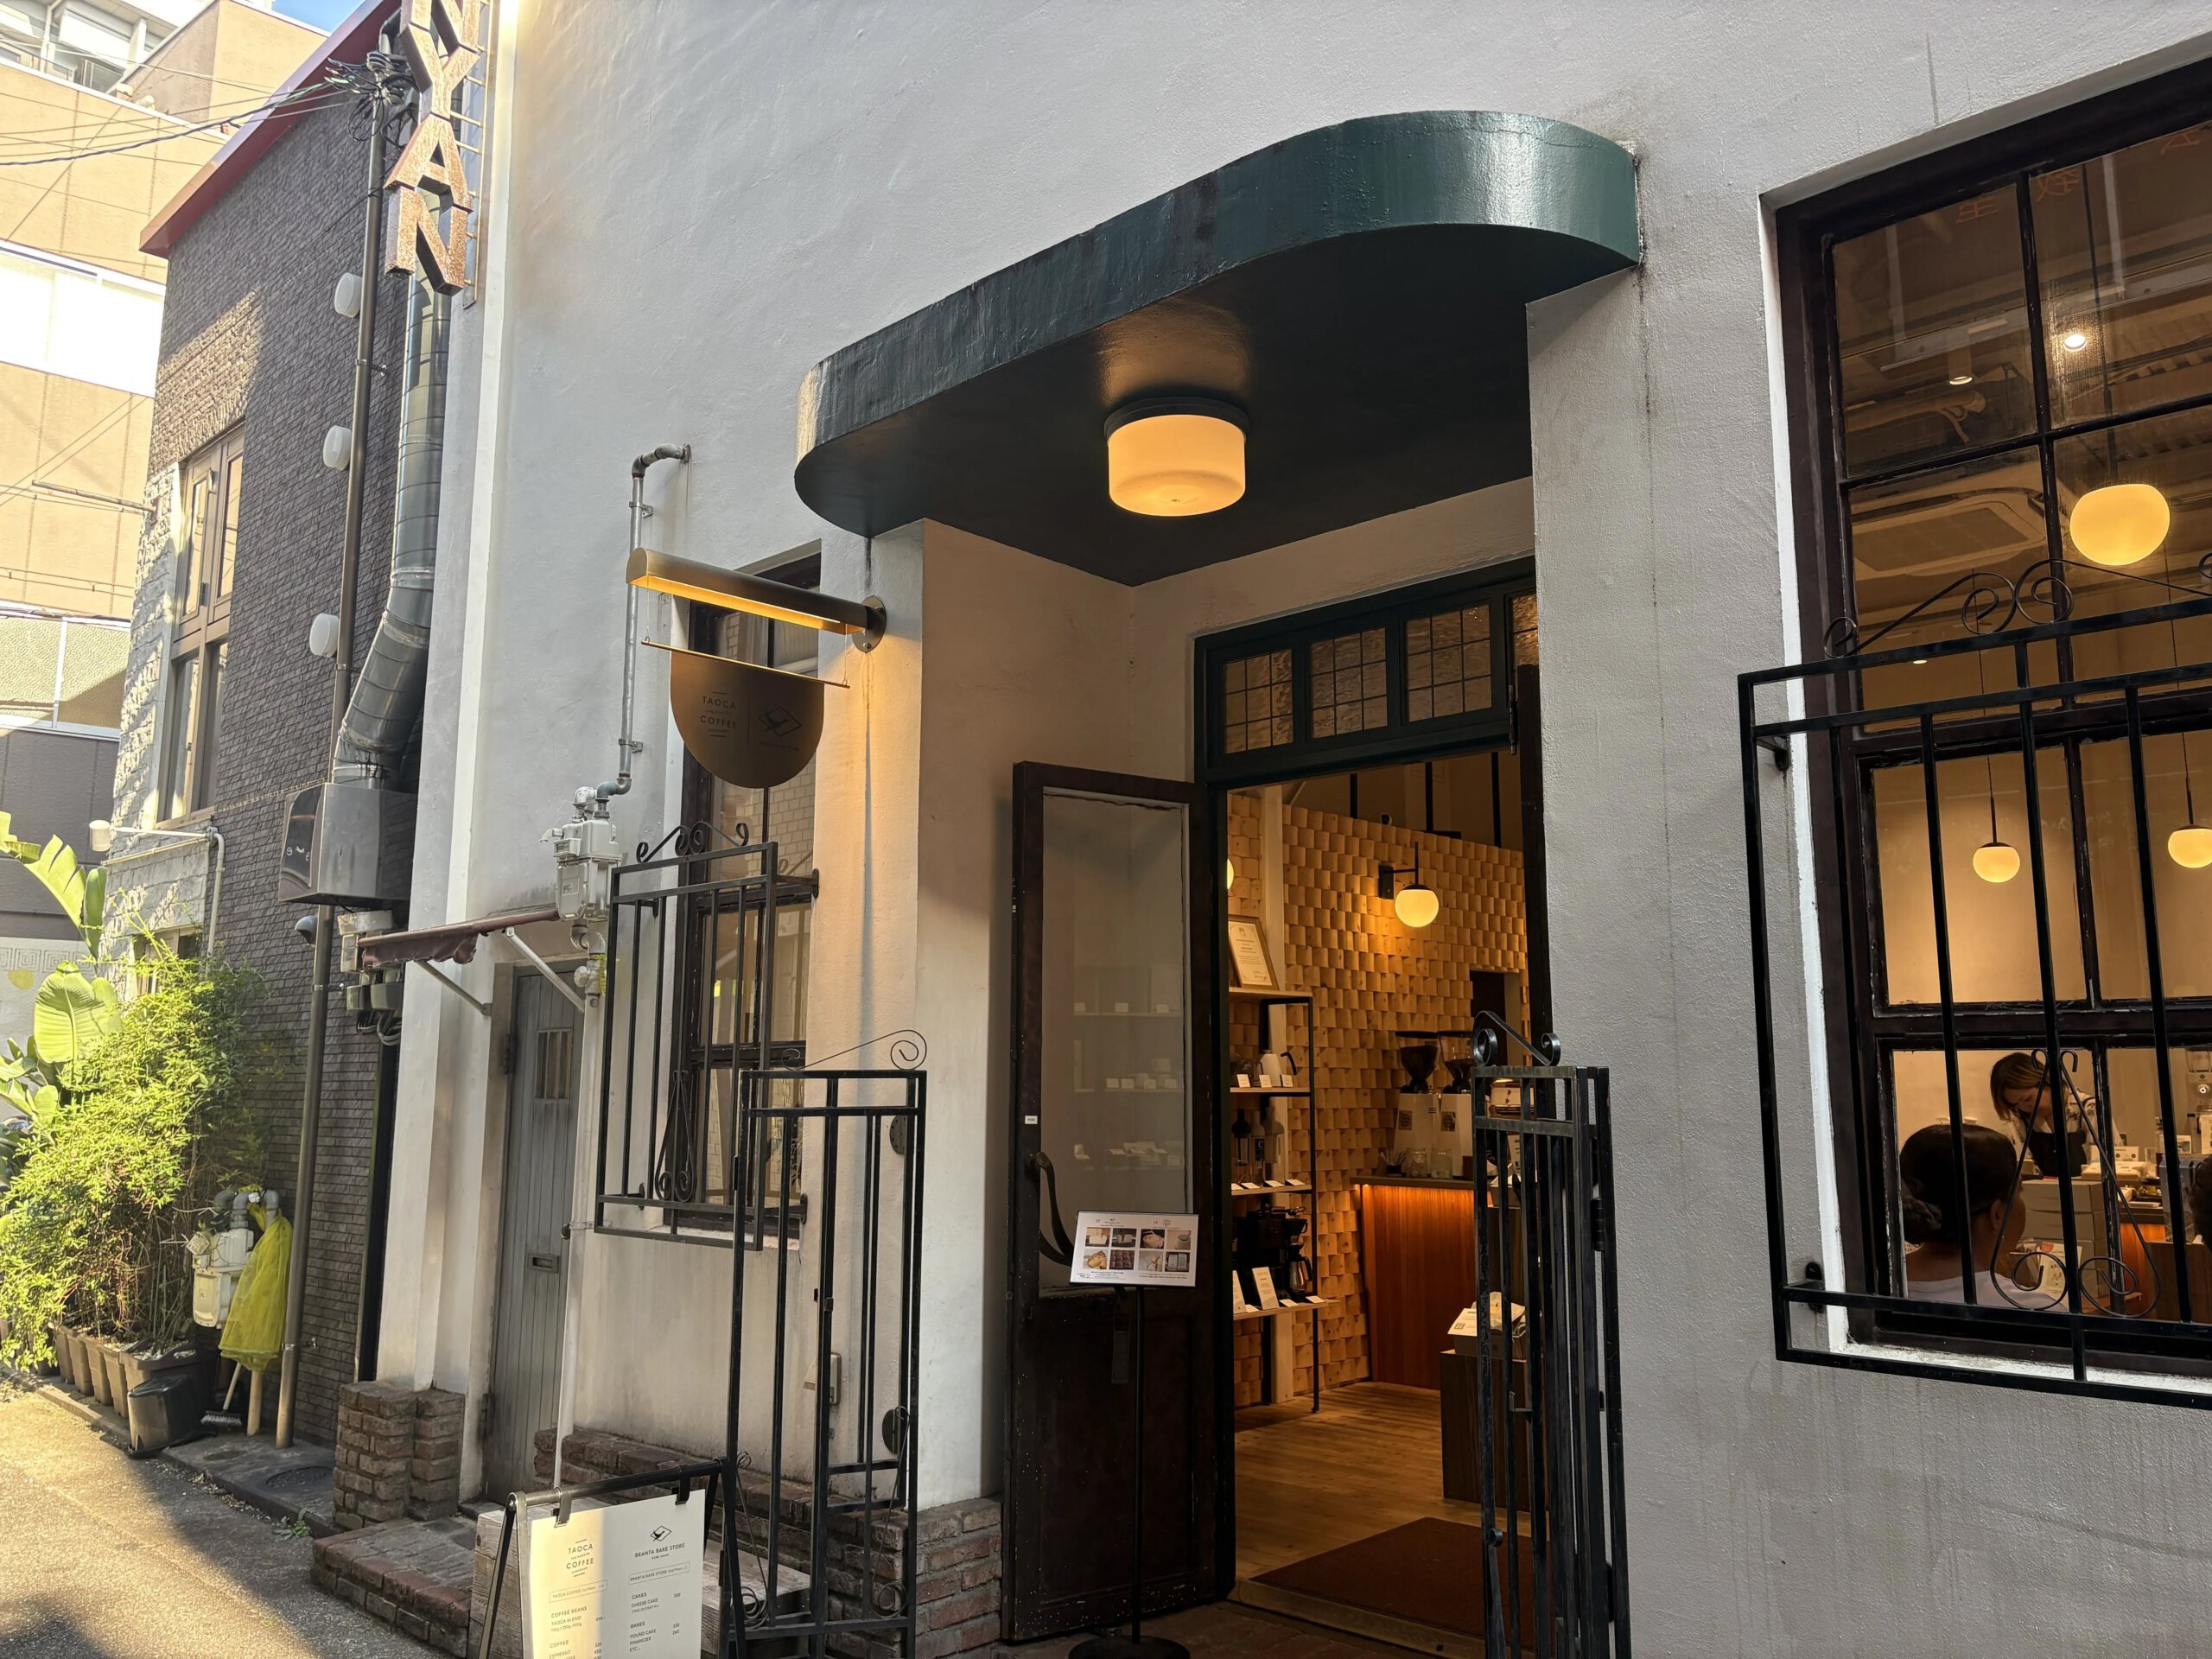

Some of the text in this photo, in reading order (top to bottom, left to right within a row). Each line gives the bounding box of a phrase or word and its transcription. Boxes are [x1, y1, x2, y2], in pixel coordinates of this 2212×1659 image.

[702, 696, 736, 709] TAOCA
[700, 715, 736, 729] COFFEE
[568, 1543, 594, 1554] TAOCA
[635, 1549, 654, 1558] BRANTA
[670, 1542, 685, 1551] STORE
[566, 1558, 594, 1569] COFFEE
[550, 1605, 588, 1618] COFFEE BEANS
[550, 1639, 569, 1649] COFFEE
